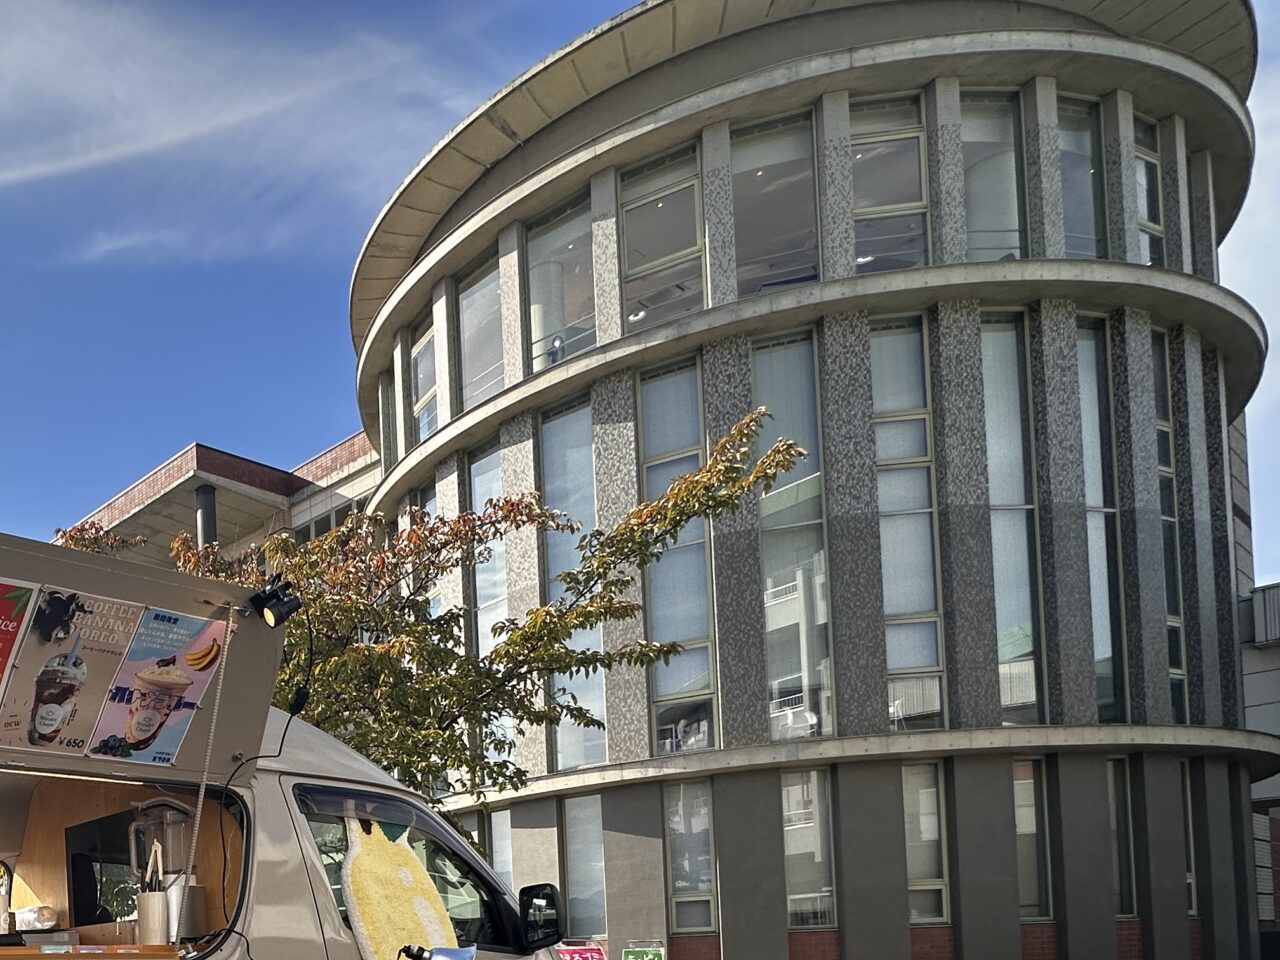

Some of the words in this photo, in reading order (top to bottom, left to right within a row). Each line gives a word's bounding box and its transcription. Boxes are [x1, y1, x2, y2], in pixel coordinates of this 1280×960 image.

[84, 600, 137, 618] COFFEE
[72, 611, 134, 633] BANANA
[80, 628, 118, 644] OREO
